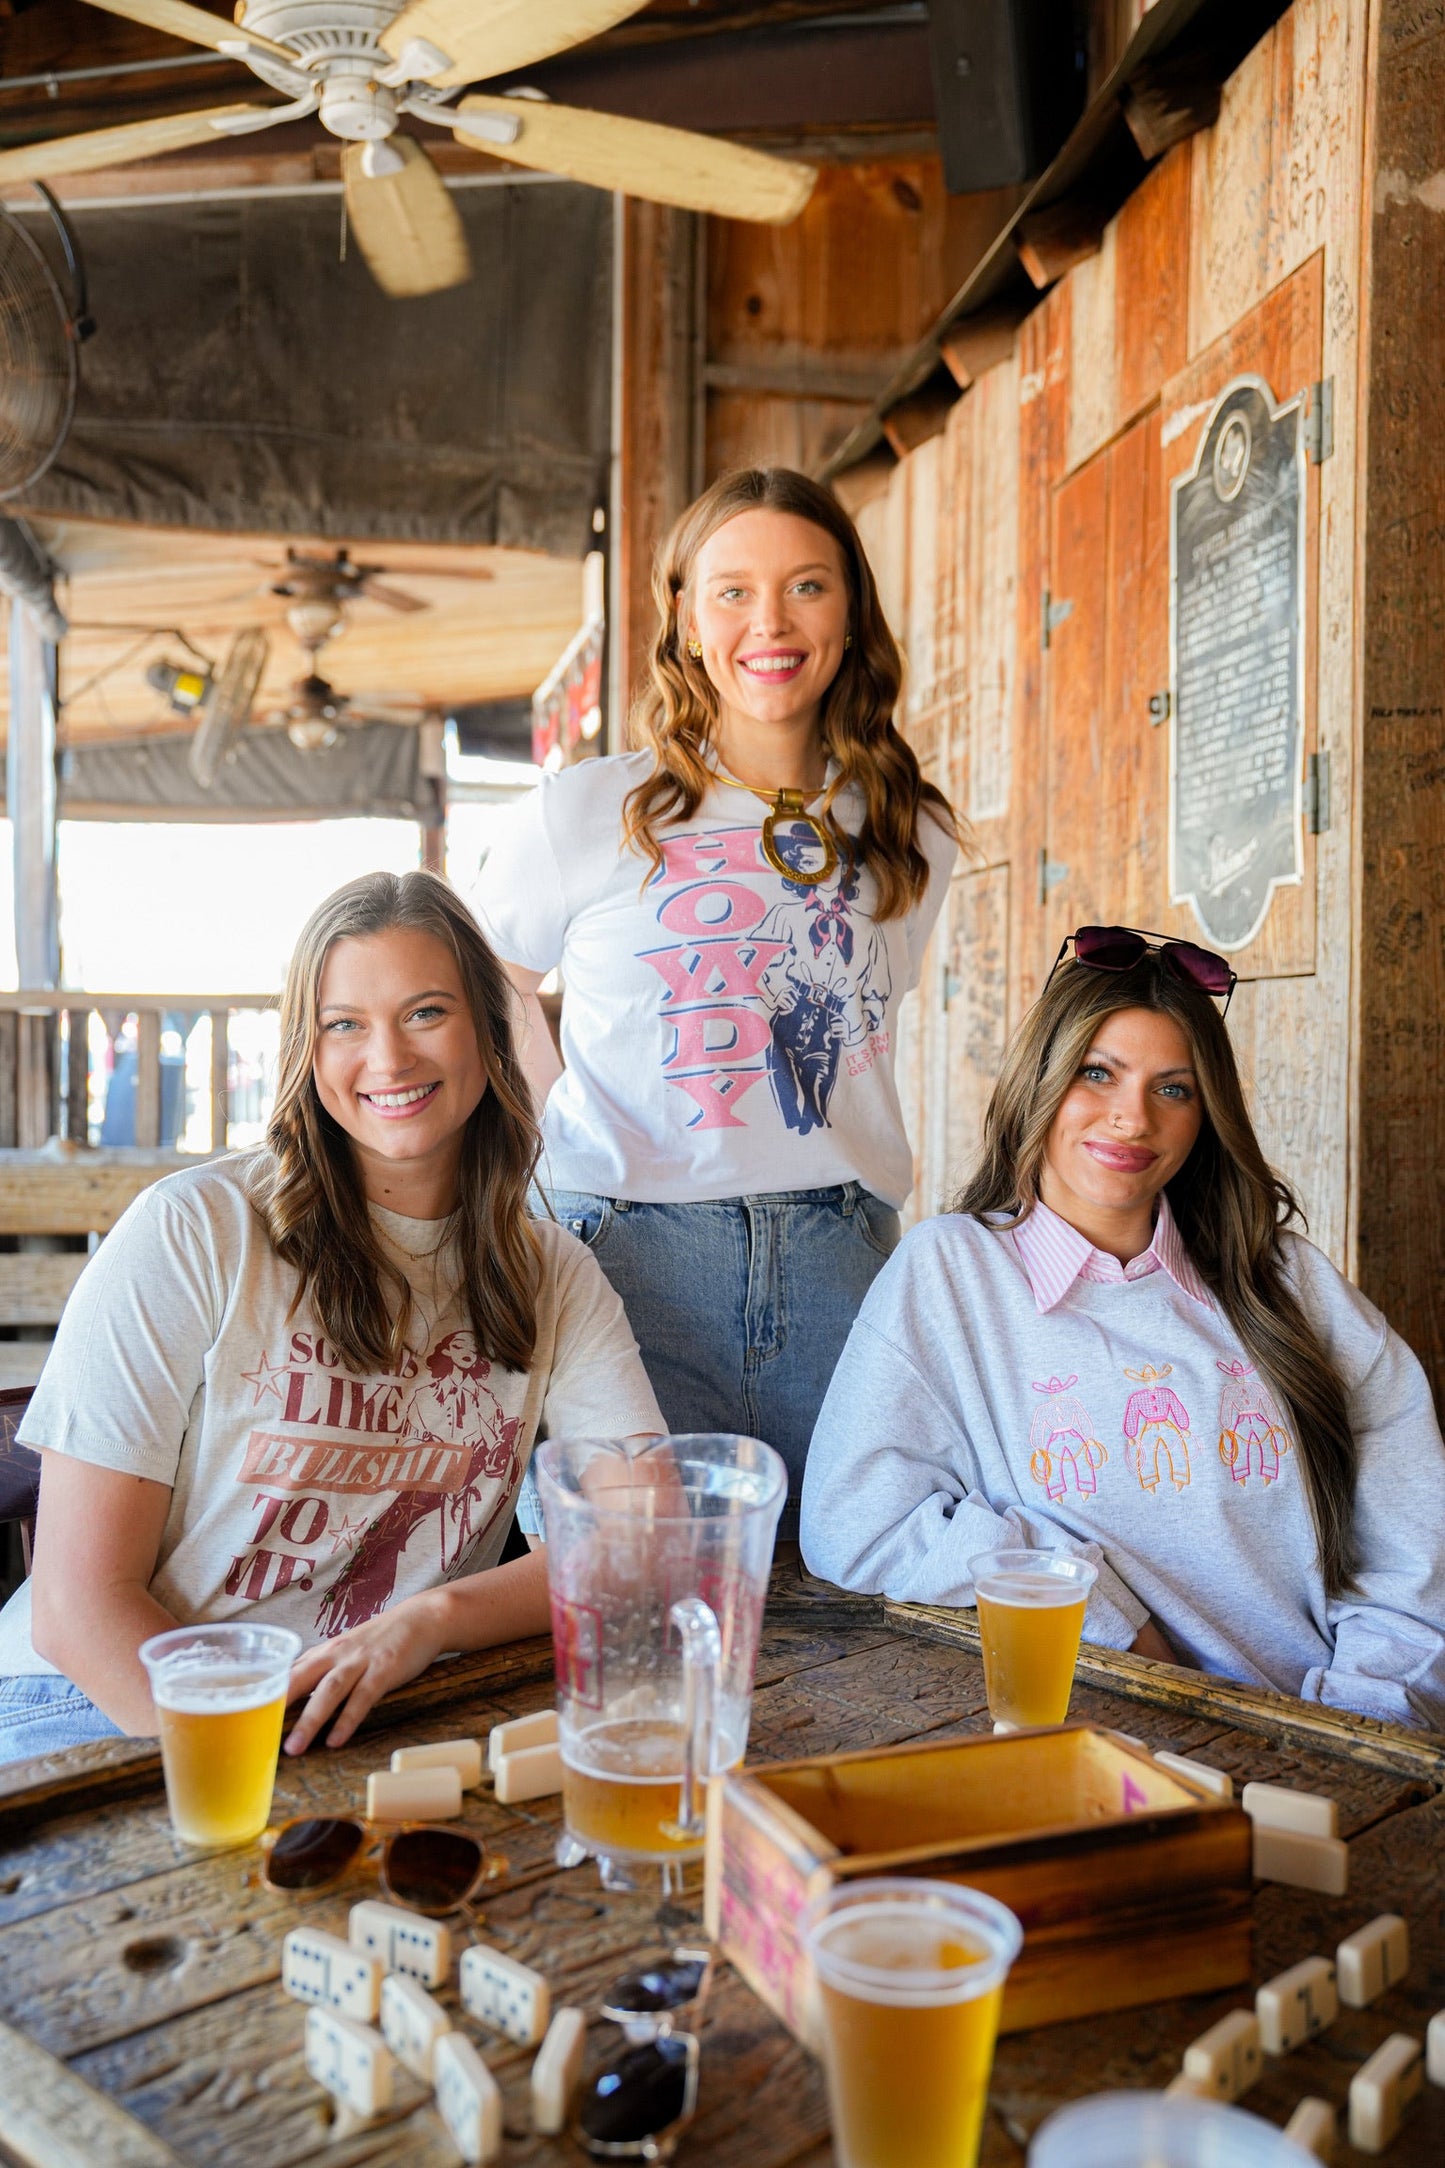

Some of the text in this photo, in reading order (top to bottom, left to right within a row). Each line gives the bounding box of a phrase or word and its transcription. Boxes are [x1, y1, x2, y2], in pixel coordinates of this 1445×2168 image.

[634, 826, 793, 1131] HOWDY
[848, 1057, 873, 1076] GET
[289, 1332, 418, 1379] SOS
[280, 1371, 404, 1434] LIKE
[252, 1440, 463, 1486] BULLSHIT
[246, 1493, 329, 1545] TO
